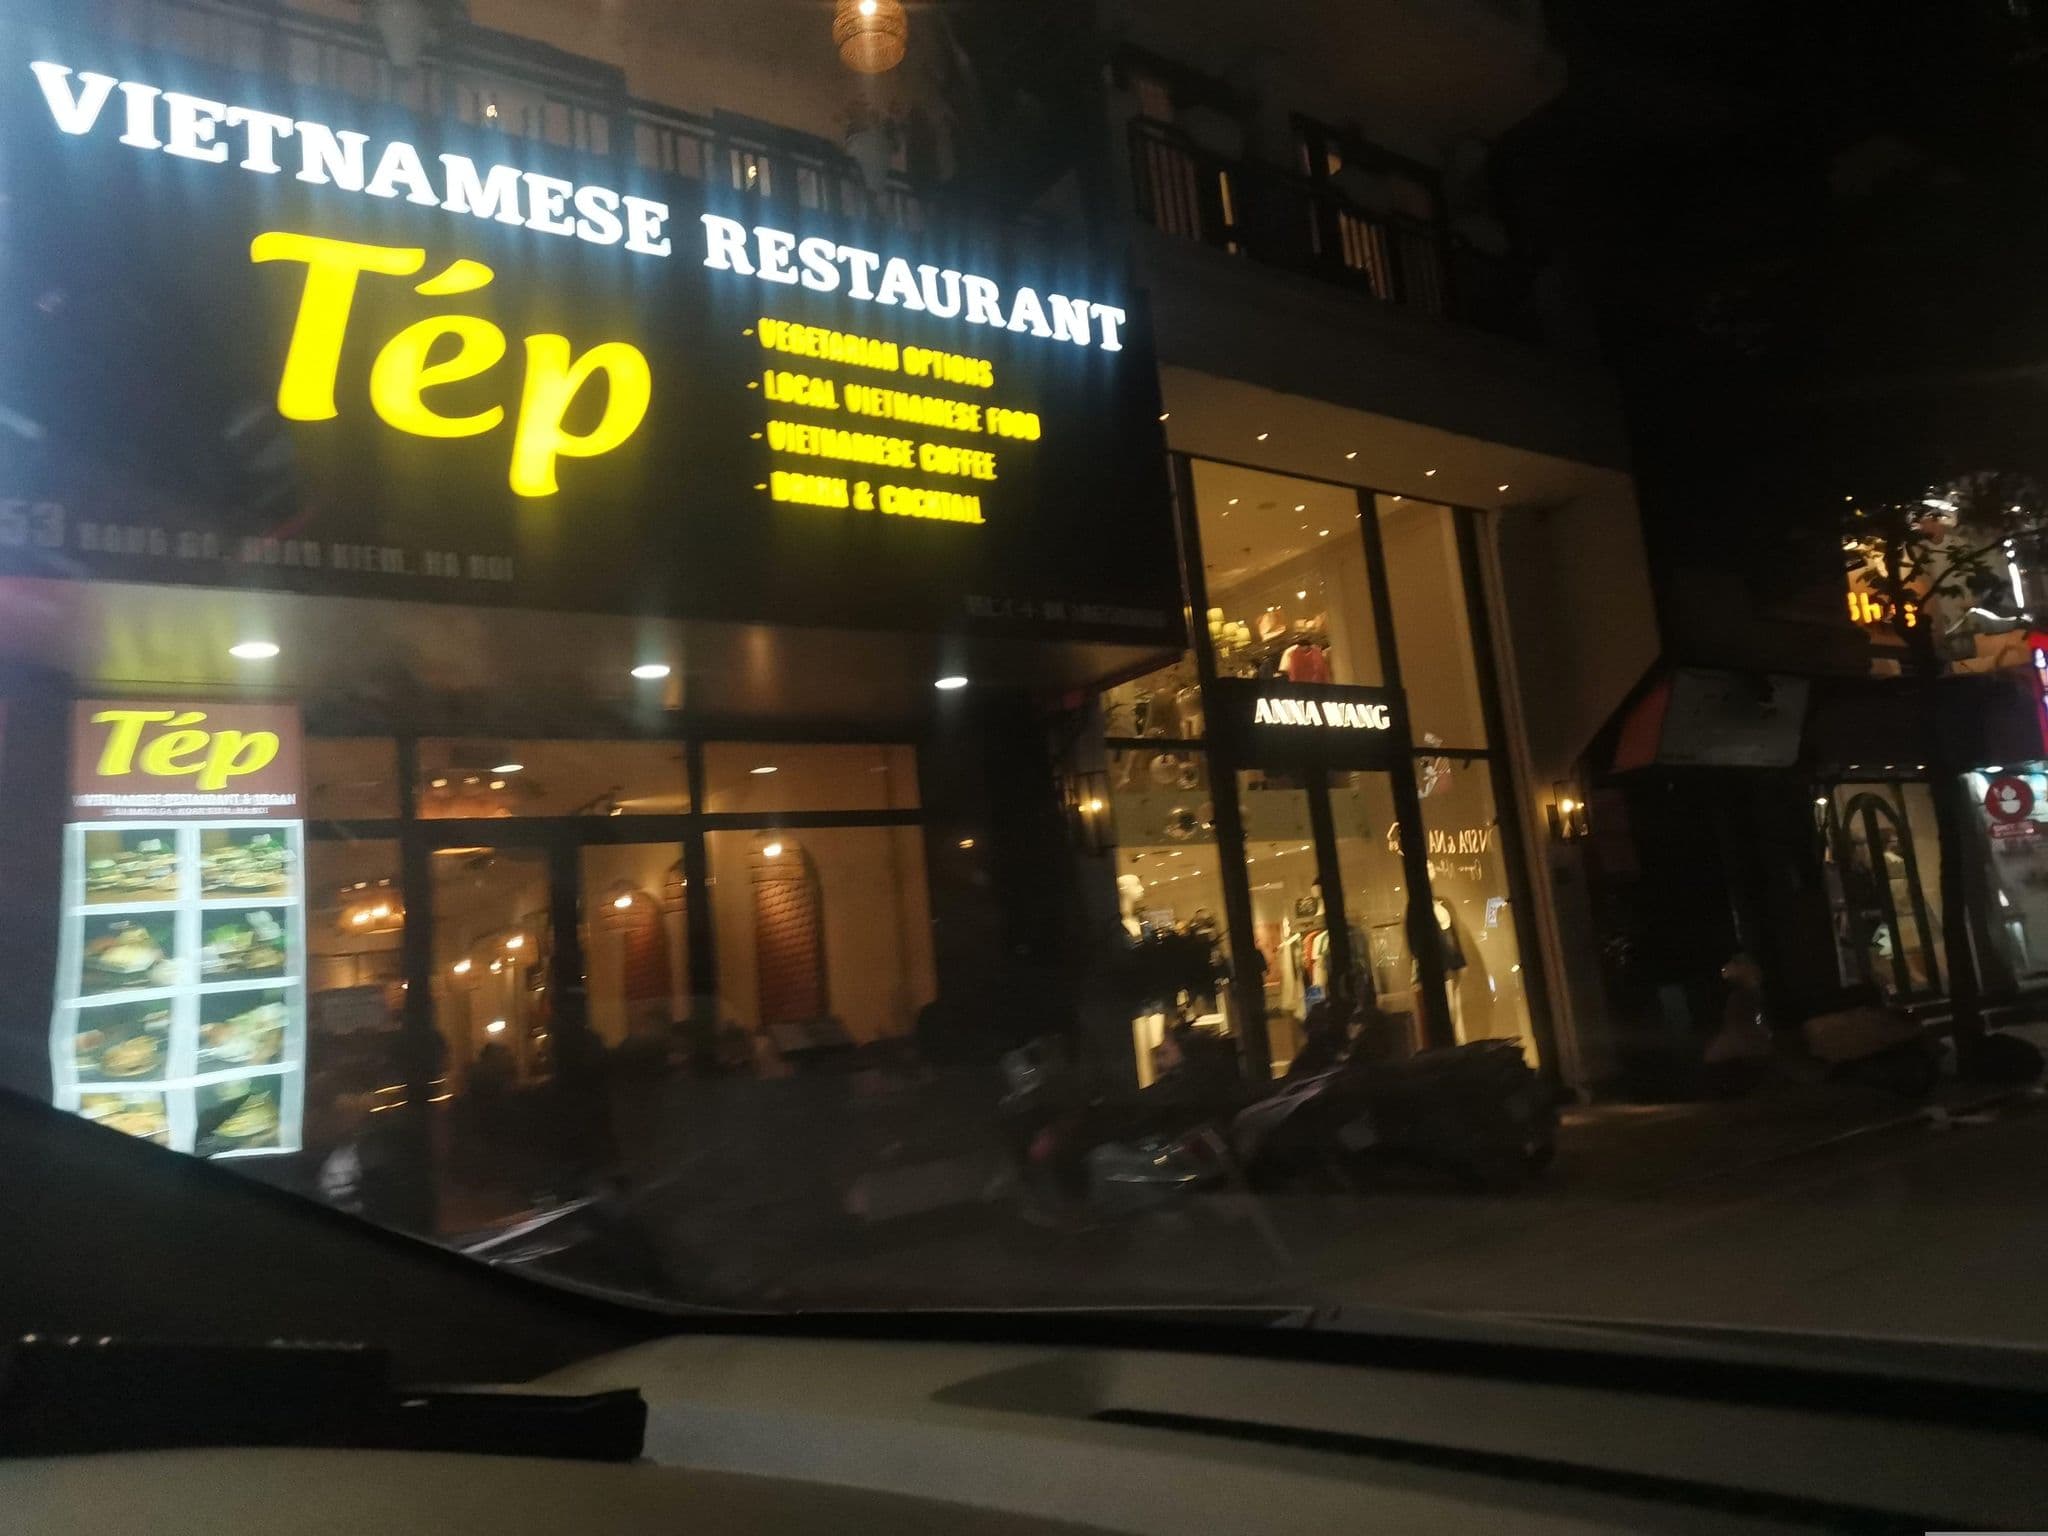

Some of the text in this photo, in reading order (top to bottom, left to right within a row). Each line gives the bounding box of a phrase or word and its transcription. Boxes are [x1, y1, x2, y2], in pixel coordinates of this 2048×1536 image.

[30, 61, 1126, 352] VIETNAMESE RESTAURANT
[250, 231, 651, 497] Tép
[758, 317, 994, 388] VEGETARIAN OPTIONS
[763, 369, 1041, 441] LOCAL VIETNAMESE FOOD
[766, 420, 998, 480] VIETNAMESE COFFEE
[853, 481, 875, 510] &
[879, 484, 986, 524] COCKTAIL
[1255, 698, 1391, 730] ANNA WANG
[90, 710, 280, 791] Tép
